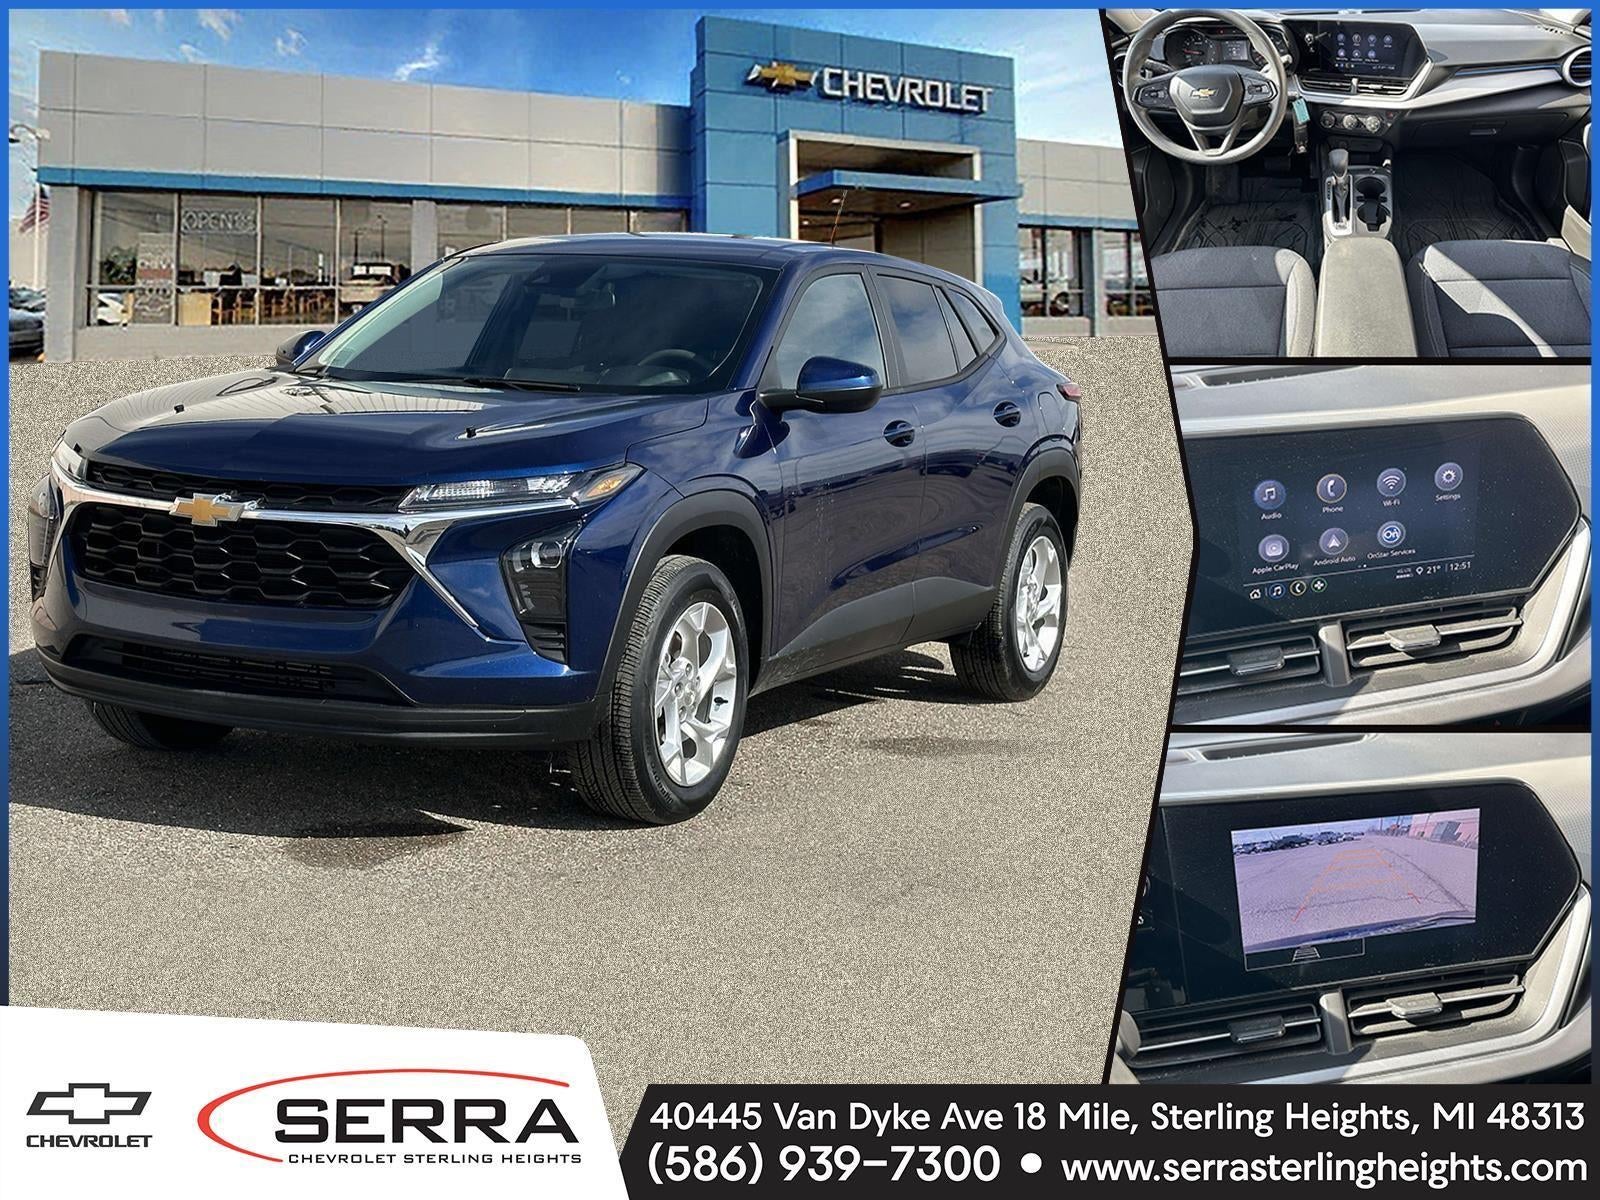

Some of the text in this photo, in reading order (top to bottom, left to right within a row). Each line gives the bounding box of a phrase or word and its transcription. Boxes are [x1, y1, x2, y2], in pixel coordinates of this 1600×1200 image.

[822, 67, 994, 112] CHEVROLET
[1382, 499, 1401, 507] Wi-Fi
[1435, 493, 1462, 502] Settings
[1322, 505, 1344, 513] Phone
[1260, 511, 1283, 520] Audio
[1366, 548, 1416, 560] OnStar Services
[1313, 555, 1356, 567] Android Auto
[1449, 560, 1472, 571] 12:51
[1252, 561, 1300, 575] Apple CarPlay
